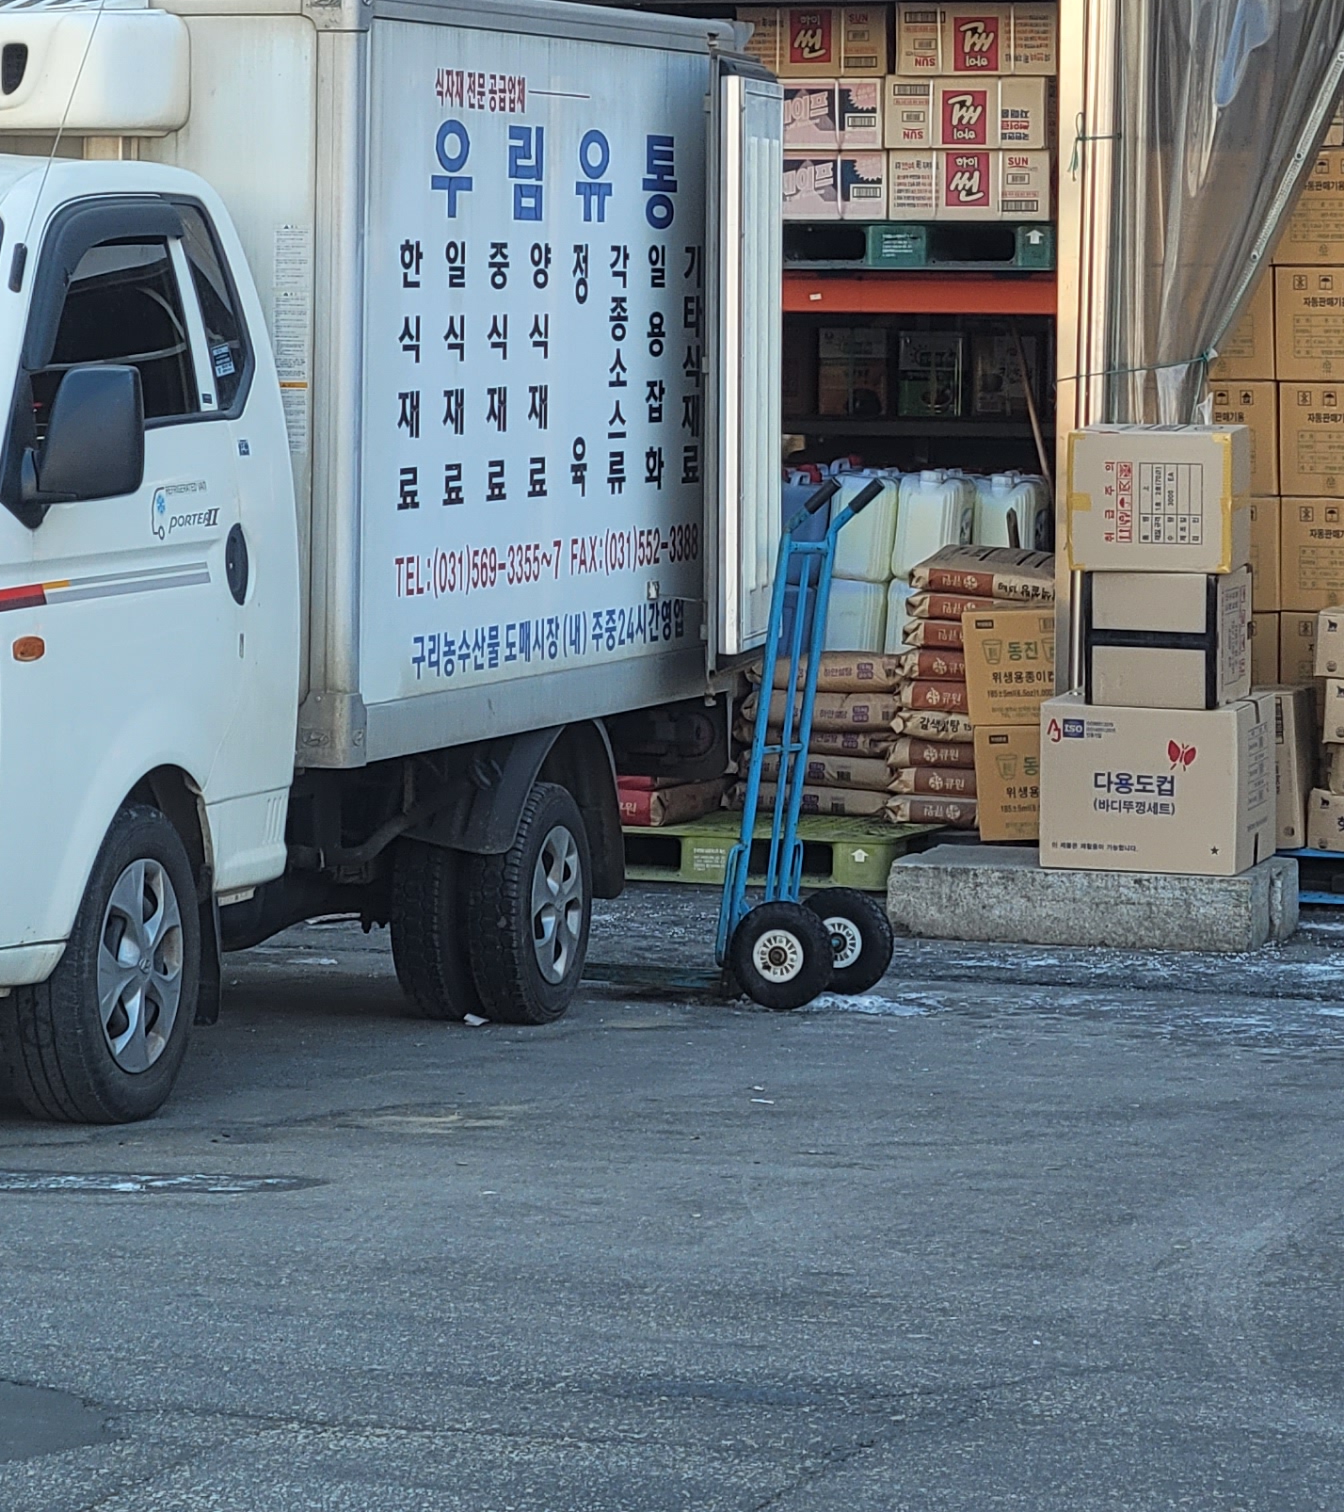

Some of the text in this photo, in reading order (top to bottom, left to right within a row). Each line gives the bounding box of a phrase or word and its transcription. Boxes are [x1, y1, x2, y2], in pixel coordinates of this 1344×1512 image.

[848, 13, 869, 24] SUN
[914, 56, 936, 67] SUN
[434, 67, 527, 114] 식자재 전문 공급업체
[784, 90, 829, 124] 이프
[902, 129, 924, 140] SUN
[1007, 156, 1029, 167] SUN
[430, 118, 678, 230] 우림유통
[1214, 411, 1245, 423] 판매기용
[1020, 584, 1055, 601] 색설탕
[411, 624, 501, 680] 구리농수산물
[1007, 640, 1039, 661] 동진
[1093, 770, 1176, 797] 다용도컵
[1093, 797, 1176, 816] (바디뚜껑세트)
